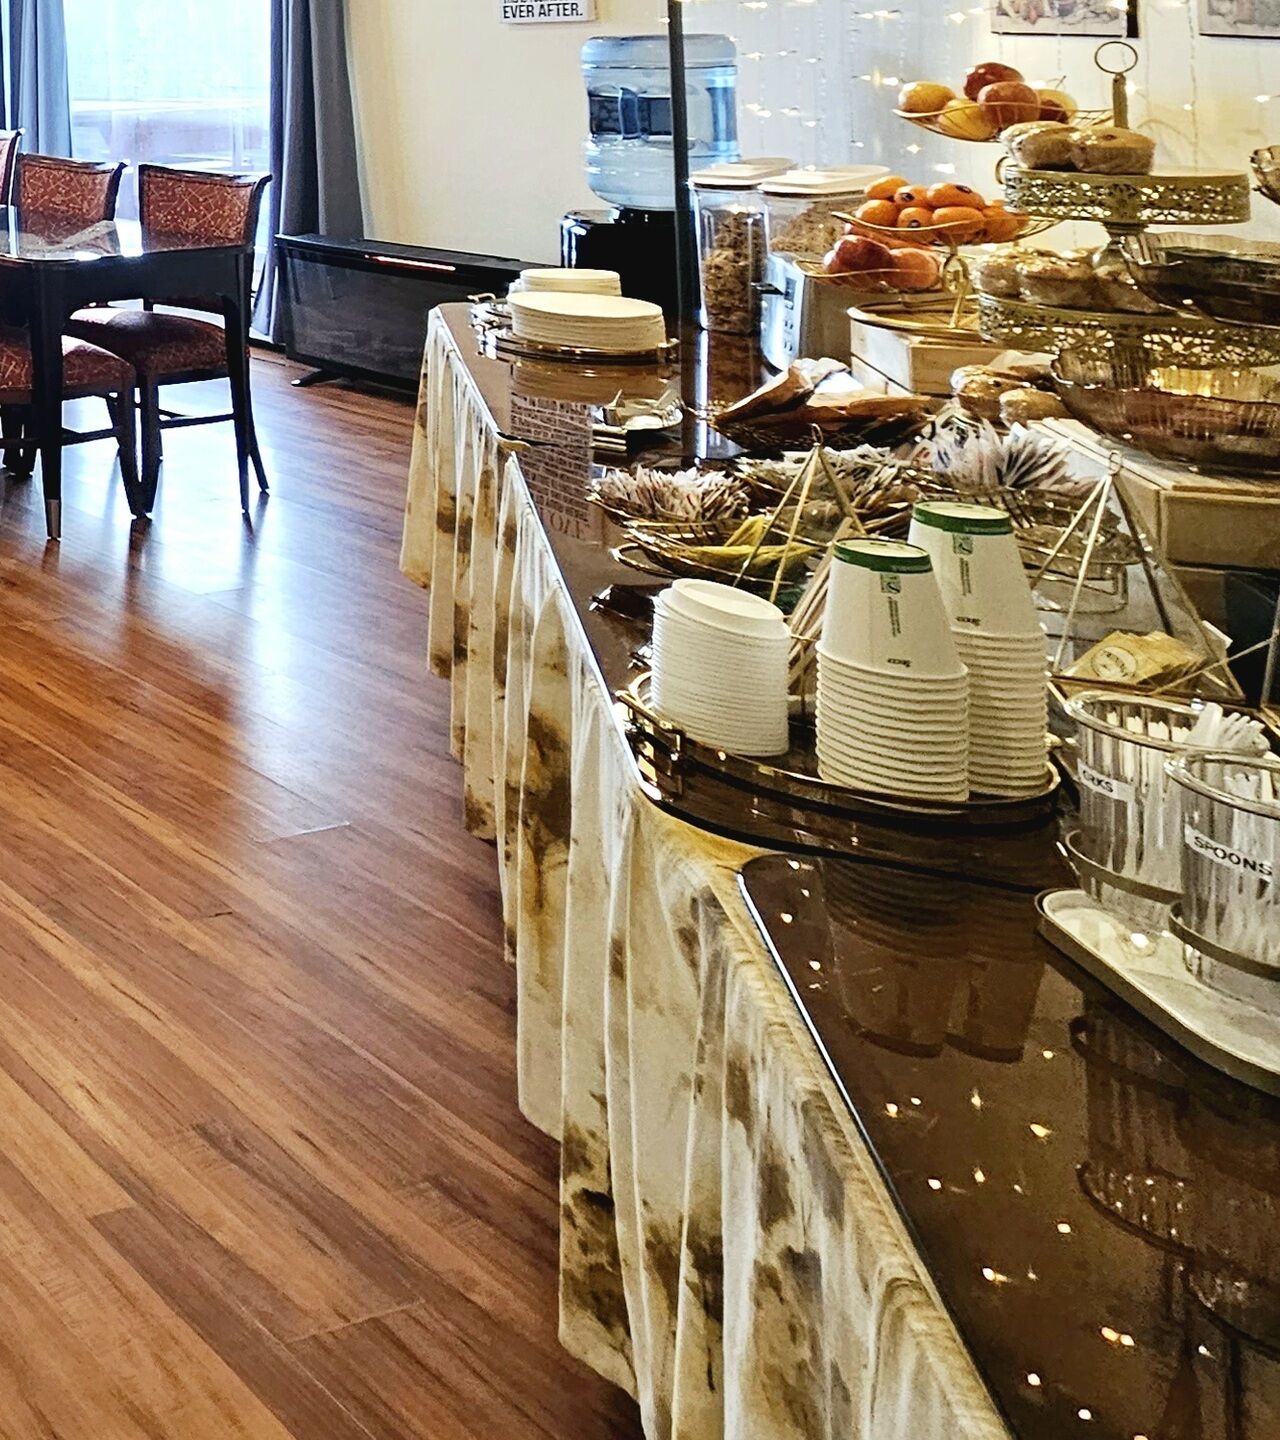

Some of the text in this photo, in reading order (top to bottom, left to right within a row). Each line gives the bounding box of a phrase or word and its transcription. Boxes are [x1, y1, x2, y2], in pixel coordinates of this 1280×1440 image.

[503, 2, 584, 19] EVER AFTER.
[1194, 836, 1273, 876] SPOONS
